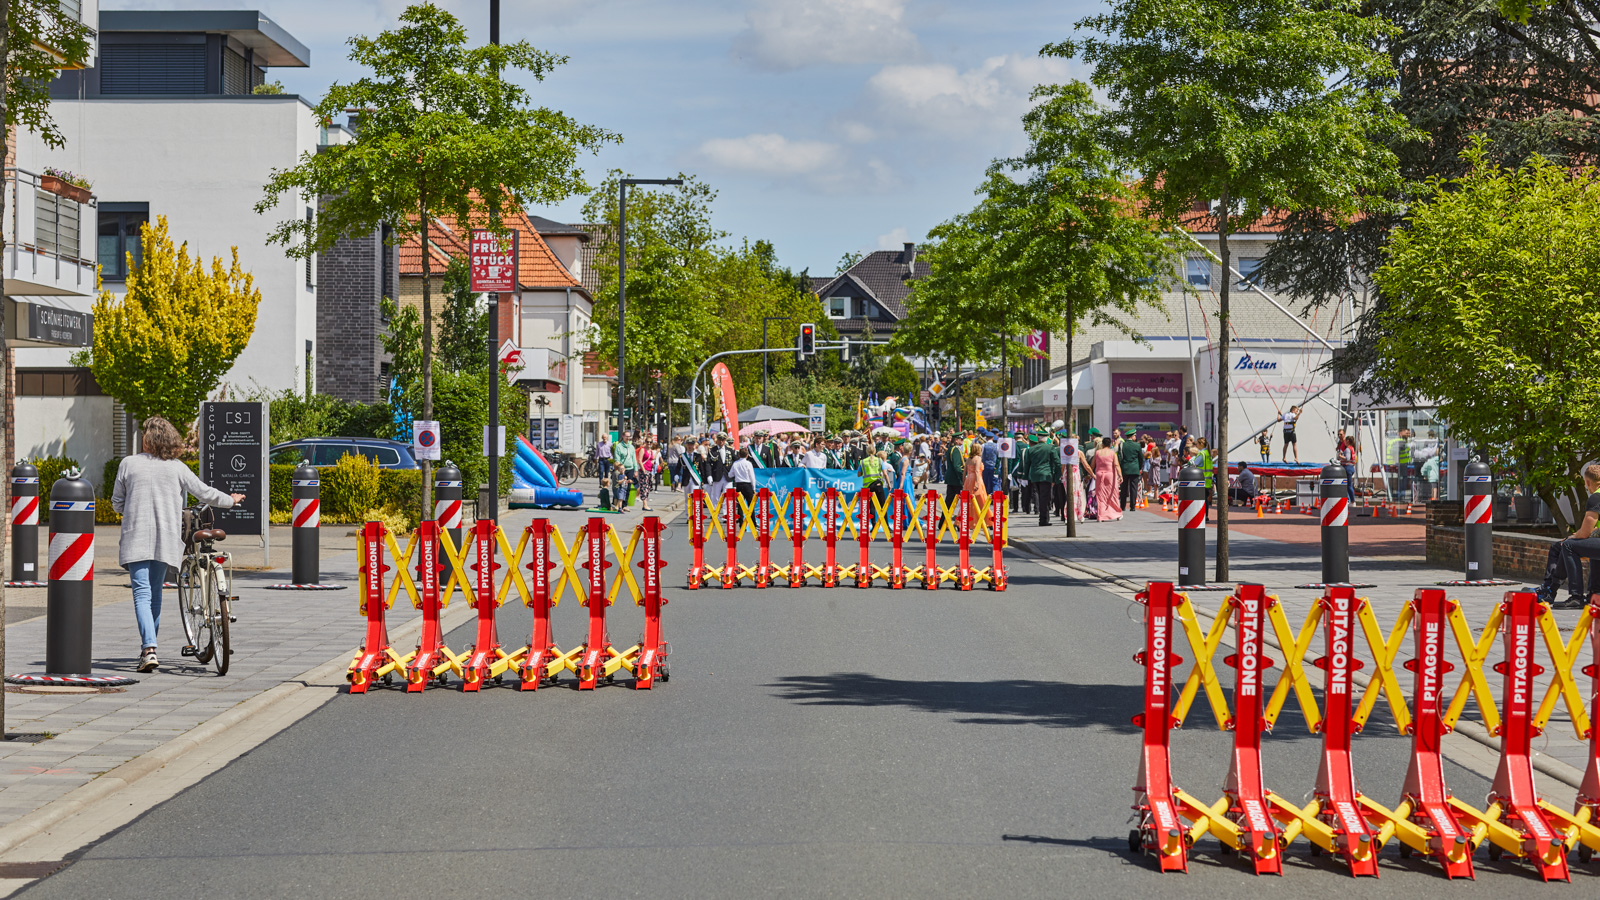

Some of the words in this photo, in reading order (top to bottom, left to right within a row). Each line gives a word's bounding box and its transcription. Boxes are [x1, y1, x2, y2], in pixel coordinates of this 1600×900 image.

[473, 254, 513, 265] STÜCK
[40, 310, 81, 329] SCHÖNHEITSWERK
[1234, 355, 1276, 370] Betten
[808, 478, 830, 489] Für
[832, 479, 854, 491] den
[370, 542, 378, 590] PITAGONE
[424, 540, 433, 588] PITAGONE
[1153, 616, 1165, 695] PITAGONE
[1240, 600, 1258, 695] PITAGONE
[1330, 599, 1348, 694] PITAGONE
[1424, 623, 1439, 701] PITAGONE
[1514, 625, 1528, 703] PITAGONE
[1156, 801, 1174, 827] PITAGONE
[1245, 800, 1268, 831] PITAGONE
[1336, 802, 1364, 833] PITAGONE
[1431, 808, 1456, 834] PITAGONE
[1522, 811, 1550, 837] PITAGONE
